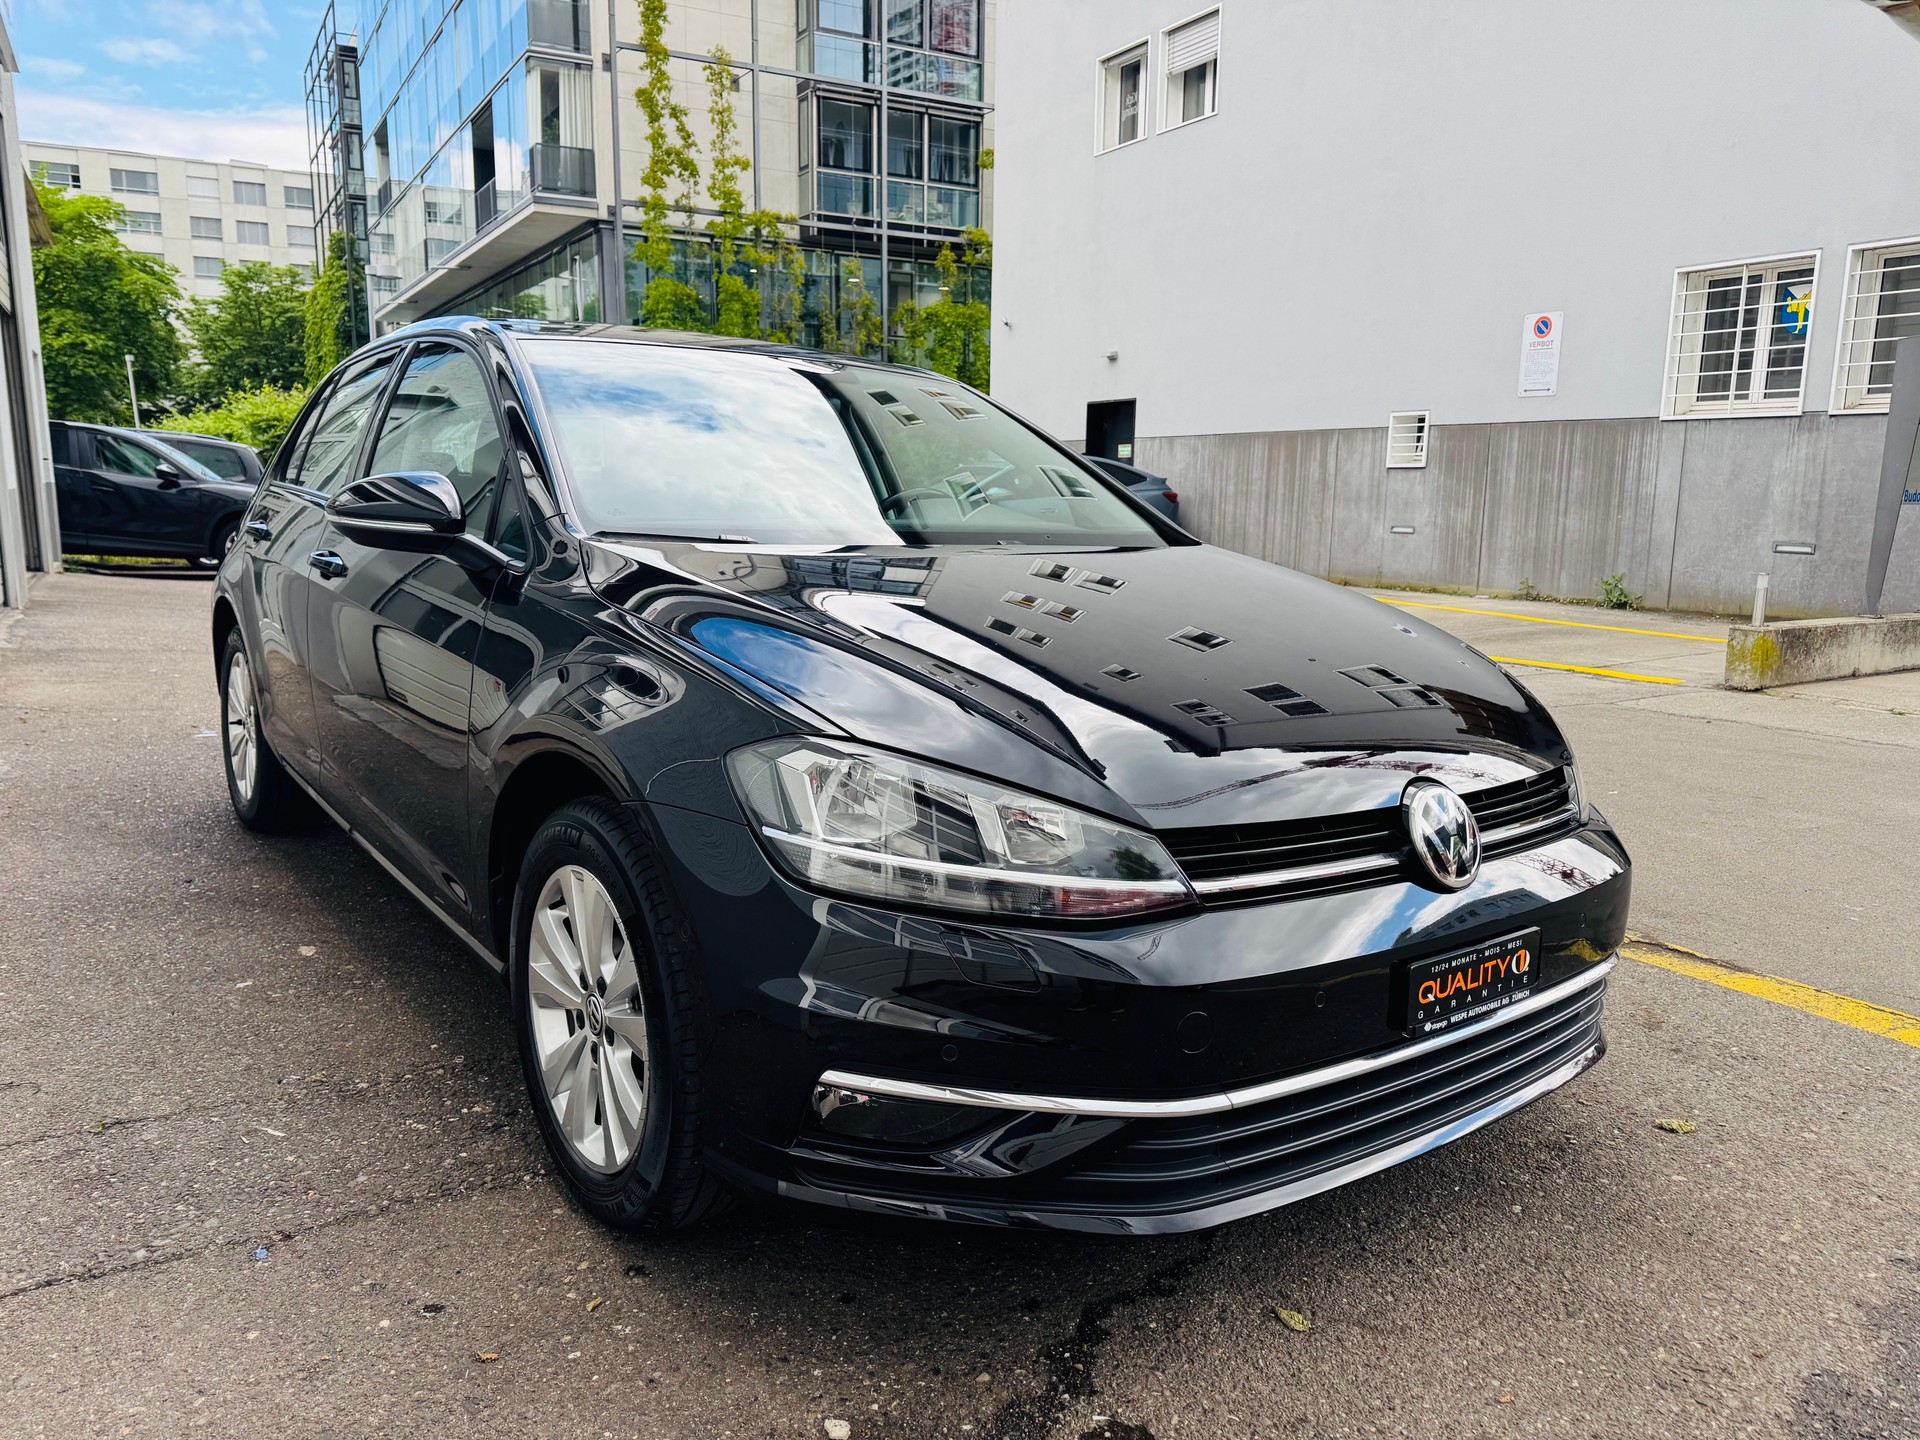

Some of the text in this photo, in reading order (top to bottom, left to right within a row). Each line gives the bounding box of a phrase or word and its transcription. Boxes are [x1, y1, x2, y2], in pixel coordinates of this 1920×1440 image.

[1529, 340, 1554, 348] VERBOT
[1431, 960, 1449, 973] 12/24
[1451, 954, 1477, 967] MONATE
[1485, 947, 1500, 957] MOIS
[1508, 939, 1523, 950] MESI
[1418, 955, 1510, 1004] QUALITY
[1450, 1009, 1468, 1023] WESPE
[1468, 999, 1502, 1018] AUTOMOBILE
[1501, 997, 1510, 1008] AG
[1512, 989, 1530, 1002] ZÜRICH
